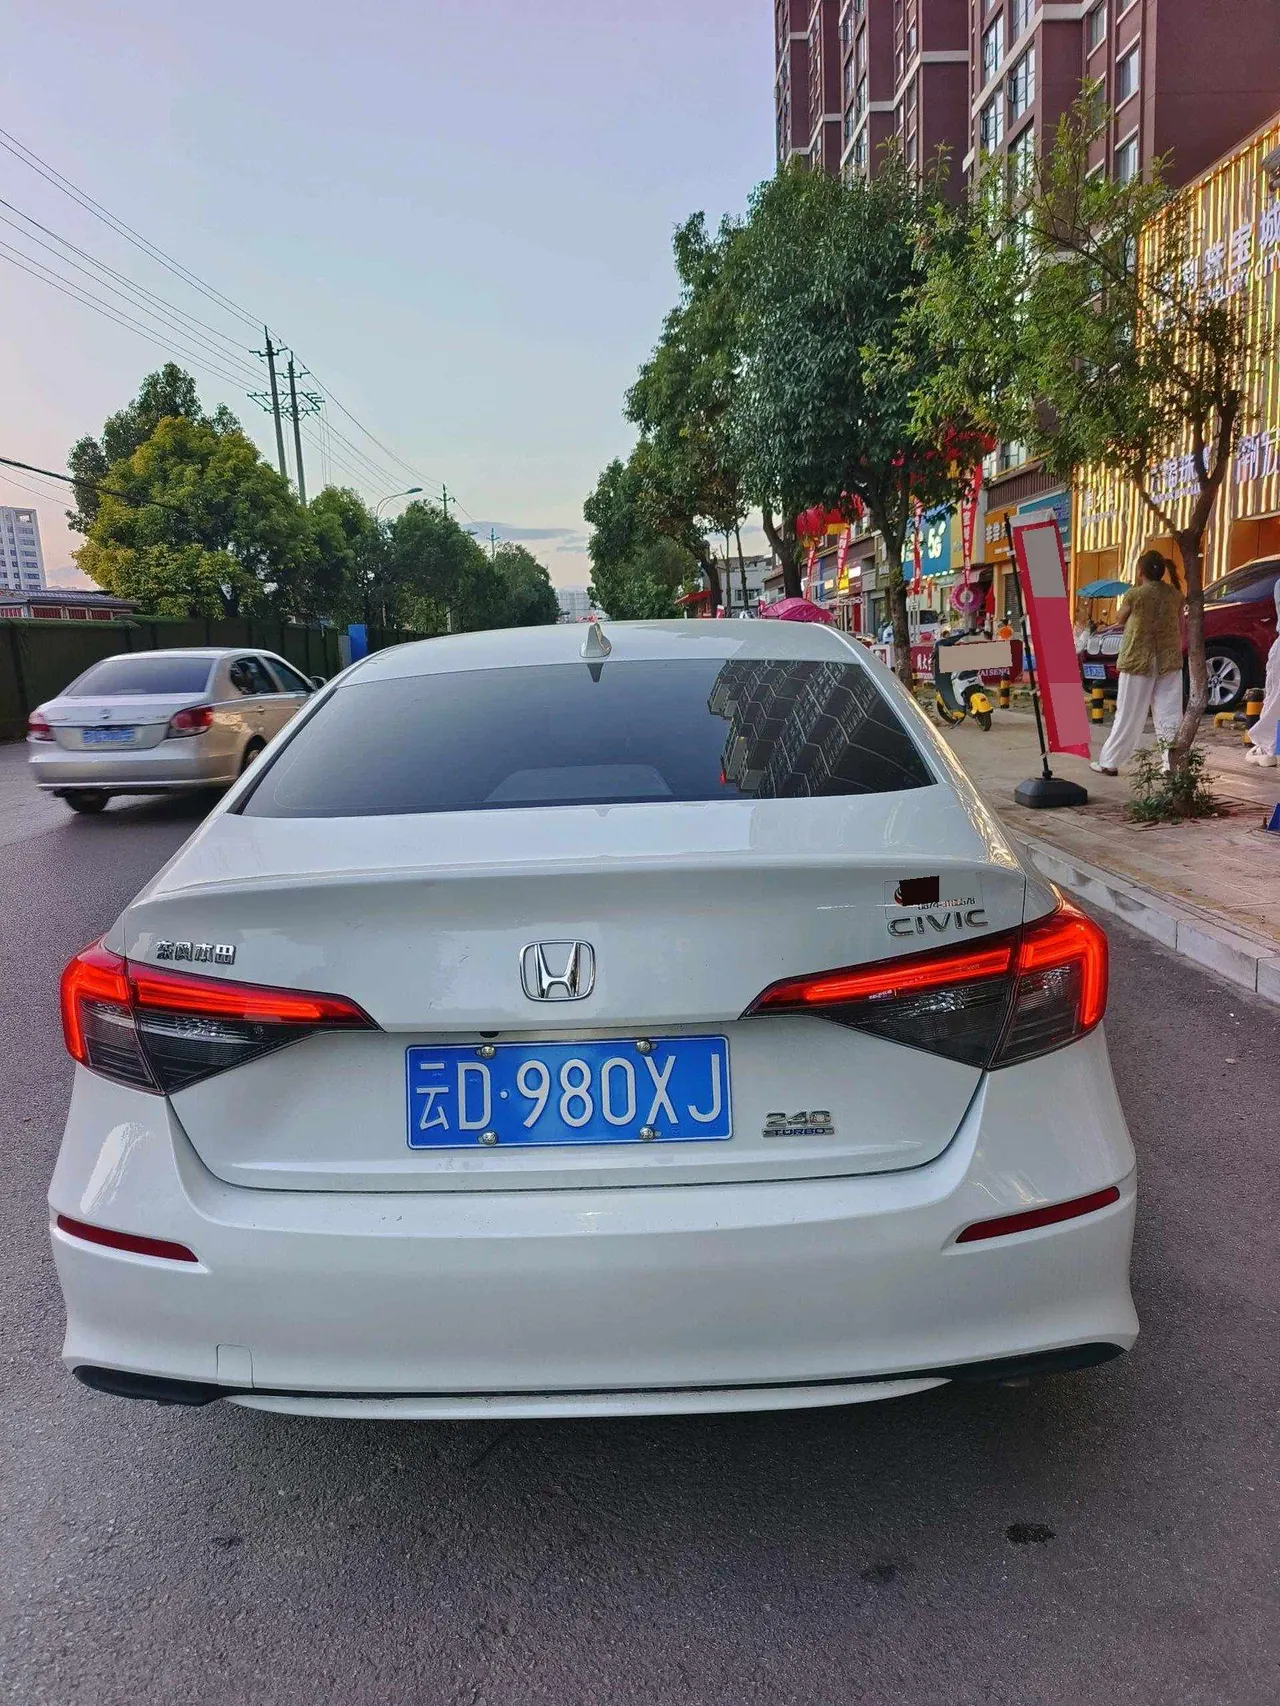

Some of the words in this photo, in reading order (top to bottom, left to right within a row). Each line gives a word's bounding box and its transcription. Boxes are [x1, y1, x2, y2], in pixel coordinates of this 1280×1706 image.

[887, 909, 989, 938] CIVIC
[156, 940, 236, 965] 东风本田
[766, 1110, 832, 1128] 240
[773, 1127, 827, 1136] TURBO
